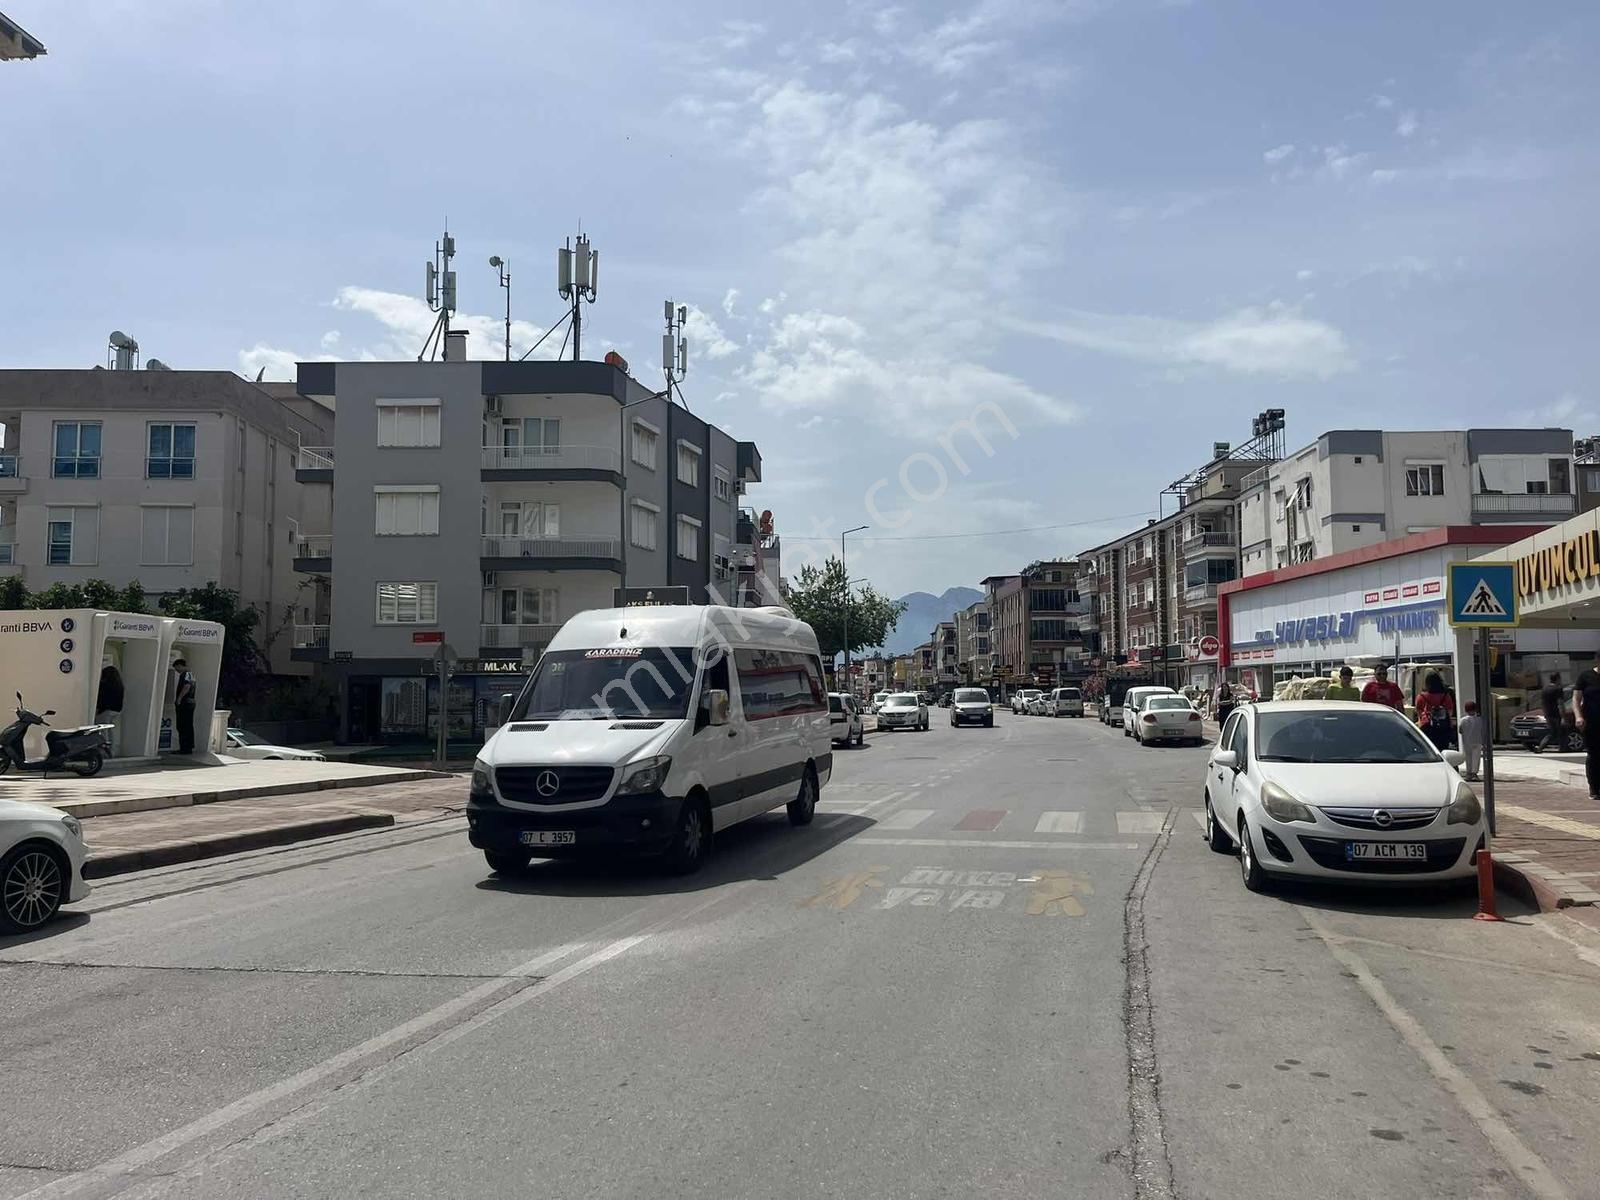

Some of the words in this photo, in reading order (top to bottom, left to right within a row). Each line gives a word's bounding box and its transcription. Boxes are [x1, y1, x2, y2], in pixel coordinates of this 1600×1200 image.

[1517, 530, 1599, 597] UYUMCUL
[22, 622, 53, 632] BBVA
[138, 623, 155, 632] BBVA
[202, 629, 218, 637] BBVA
[522, 832, 533, 843] 07
[540, 832, 545, 843] C
[551, 832, 574, 843] 3957
[1354, 844, 1369, 857] 07
[1374, 844, 1396, 857] ACM
[1403, 844, 1425, 857] 139
